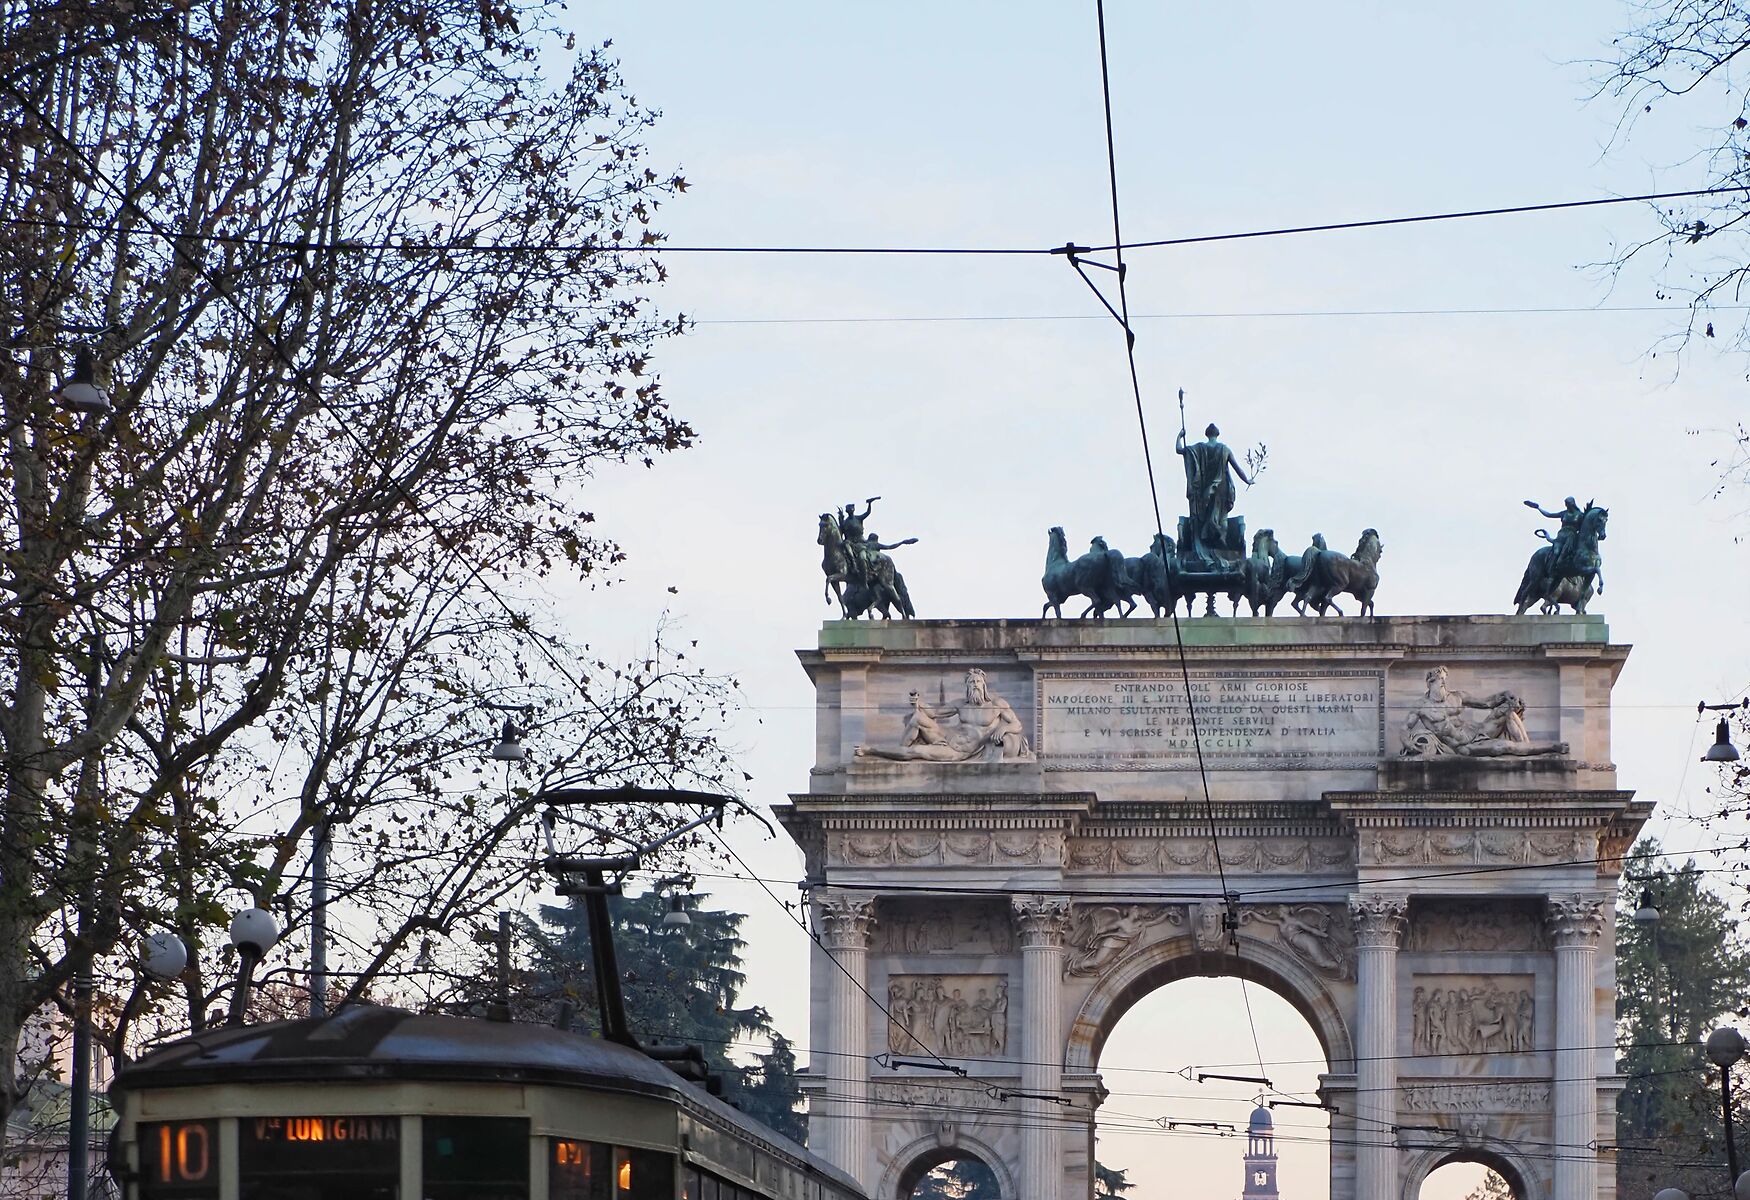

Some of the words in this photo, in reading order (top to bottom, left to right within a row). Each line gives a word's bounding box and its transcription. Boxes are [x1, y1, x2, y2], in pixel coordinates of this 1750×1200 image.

[1114, 683, 1174, 693] ENTRANDO
[1220, 683, 1246, 692] ARMI
[1255, 682, 1309, 691] GLORIOSE
[1048, 695, 1113, 704] NAPOLEONE
[1122, 695, 1133, 704] III
[1143, 695, 1149, 704] E
[1158, 694, 1211, 703] VITTORIO
[1220, 694, 1280, 703] EMANUELE
[1289, 694, 1296, 703] II
[1305, 693, 1373, 702] LIBERATORI
[1067, 707, 1111, 715] MILANO
[1120, 706, 1179, 715] ESULTANTE
[1250, 706, 1264, 714] DA
[1271, 705, 1310, 714] QUESTI
[1318, 704, 1354, 713] MARMI
[1146, 717, 1158, 726] LE
[1167, 717, 1223, 725] IMPRONTE
[1232, 716, 1274, 725] SERVILI
[1084, 729, 1090, 737] E
[1100, 729, 1111, 737] VI
[1120, 728, 1163, 737] SCRISSE
[1186, 727, 1272, 736] INDIPENDENZA
[1298, 727, 1336, 736] ITALIA
[286, 1116, 397, 1141] LUNIGIANA
[160, 1124, 209, 1183] 10
